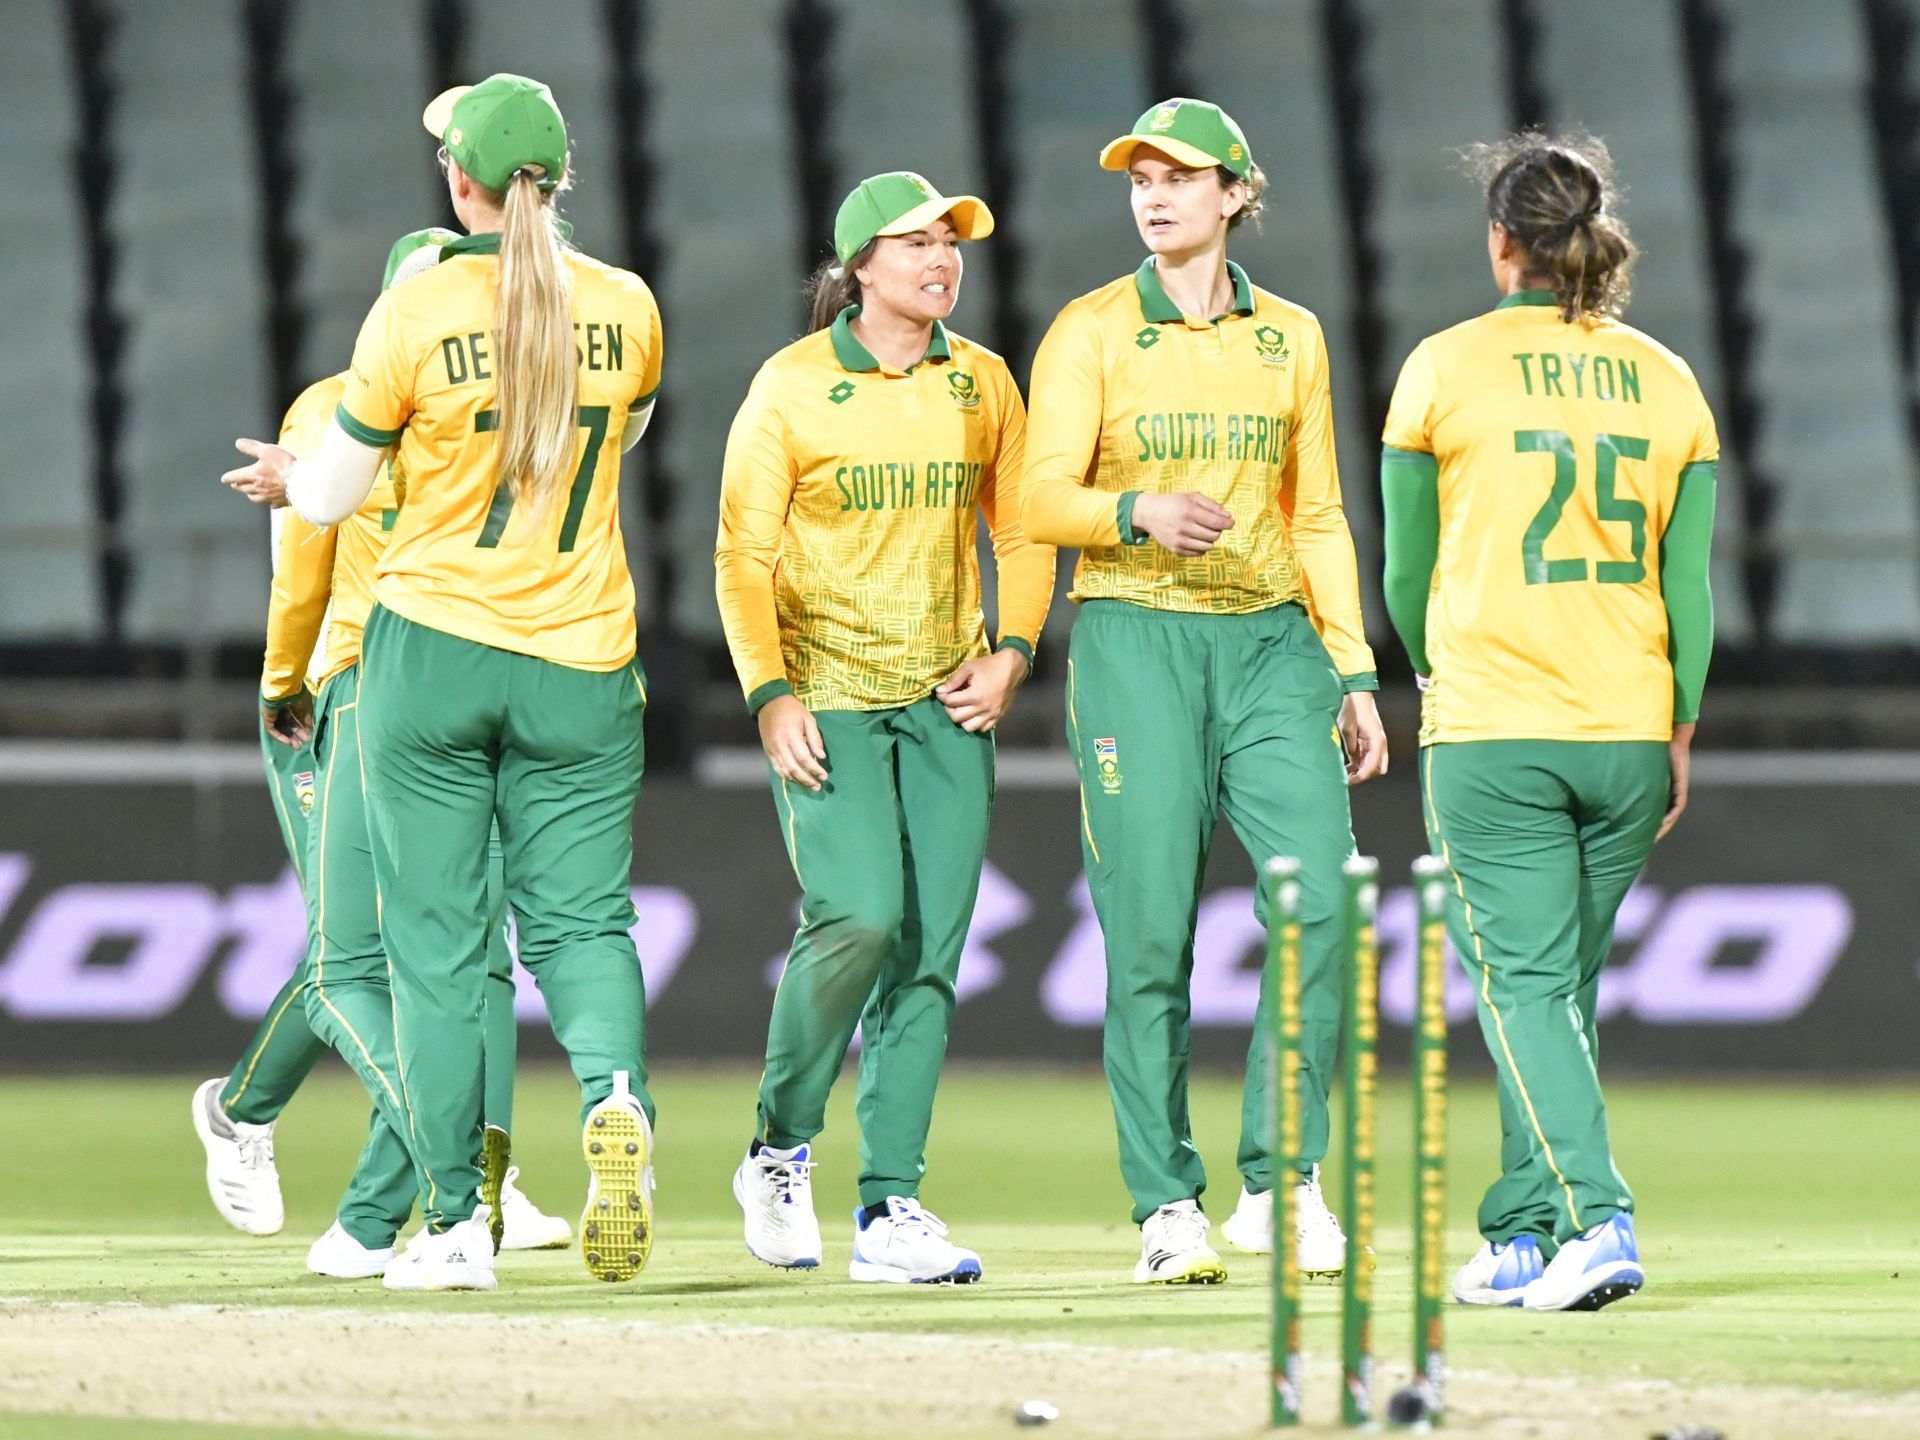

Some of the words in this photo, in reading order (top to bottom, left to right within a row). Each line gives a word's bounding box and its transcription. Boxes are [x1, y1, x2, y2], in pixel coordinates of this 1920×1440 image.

[1512, 352, 1642, 404] TRYON
[1135, 412, 1216, 463] SOUTH
[835, 463, 915, 512] SOUTH
[1514, 429, 1650, 585] 25
